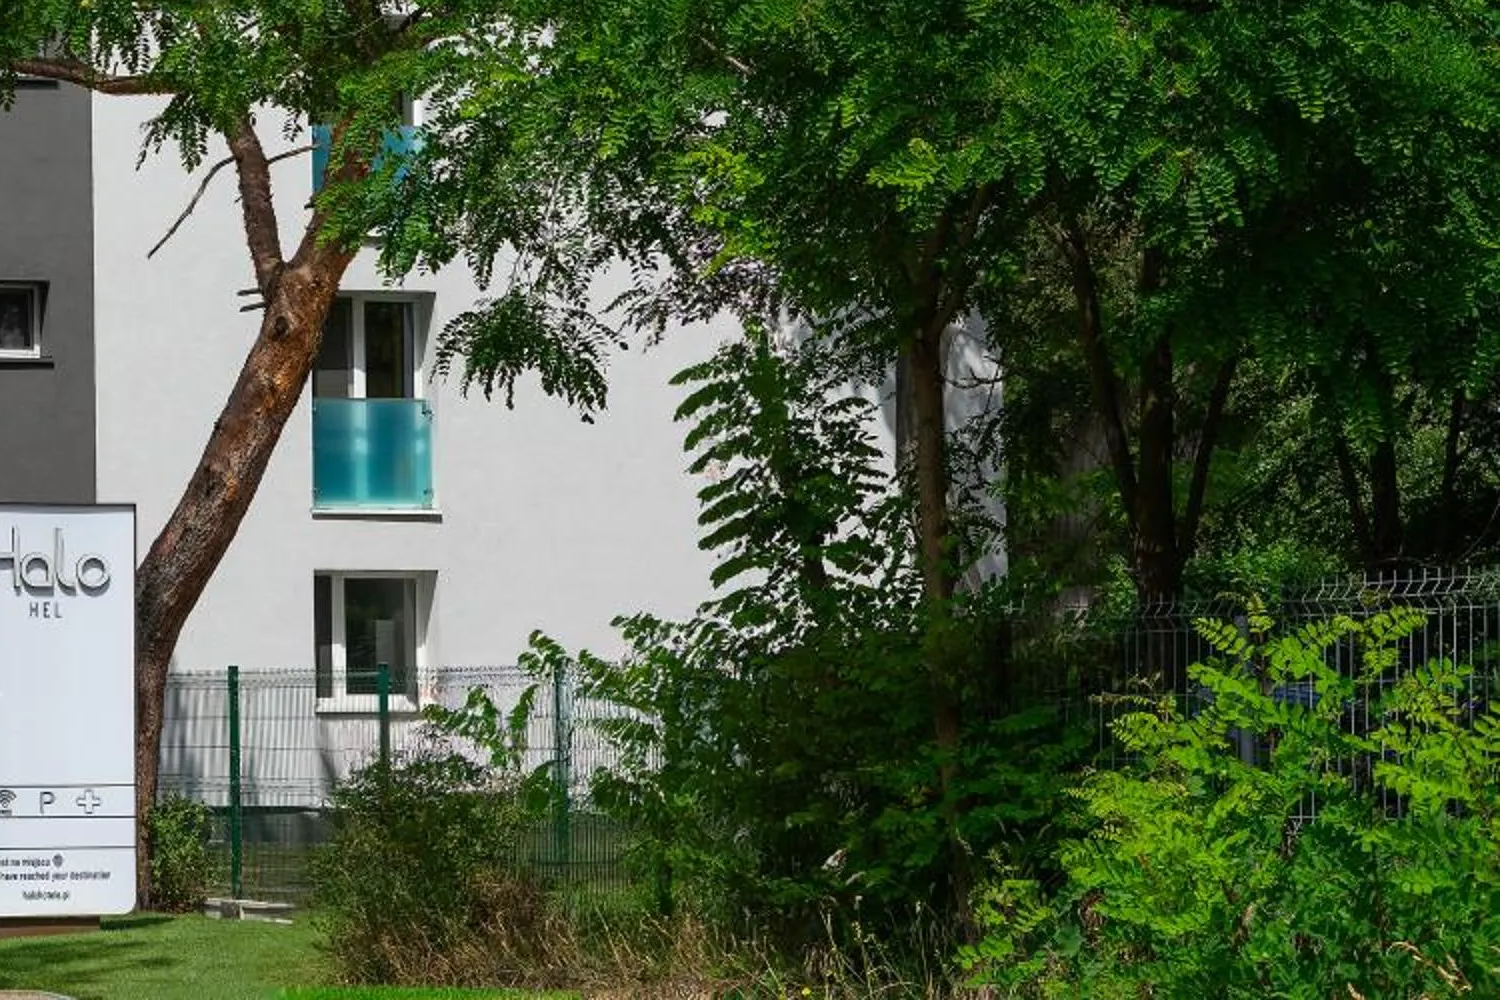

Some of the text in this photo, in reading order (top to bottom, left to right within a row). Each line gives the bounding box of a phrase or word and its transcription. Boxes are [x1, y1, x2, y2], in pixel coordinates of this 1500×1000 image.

[29, 602, 63, 619] HEL
[39, 791, 56, 814] P
[0, 871, 18, 881] have
[19, 871, 50, 881] reached
